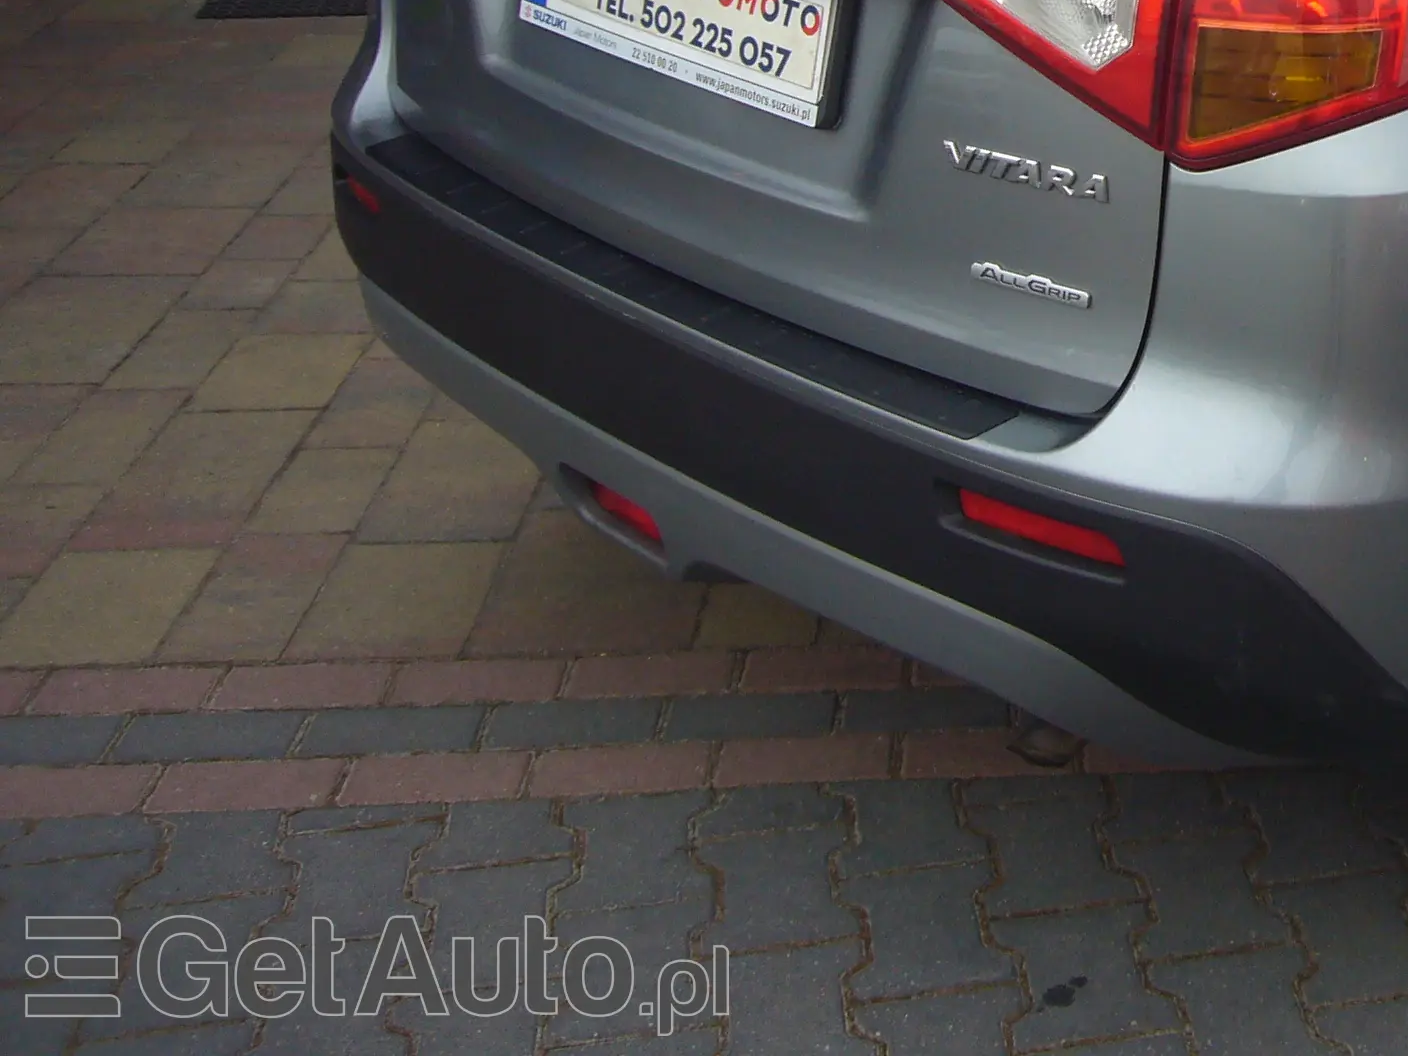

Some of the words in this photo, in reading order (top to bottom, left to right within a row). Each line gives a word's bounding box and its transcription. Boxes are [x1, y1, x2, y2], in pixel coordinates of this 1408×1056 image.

[533, 9, 567, 31] SUZUKI
[631, 47, 641, 59] 22
[642, 51, 656, 65] 510
[656, 55, 667, 68] 00
[668, 59, 678, 73] 20
[695, 71, 811, 121] www.japanmotors.suzuki.pl
[689, 18, 733, 58] 225
[739, 35, 792, 78] 057
[943, 139, 1112, 204] VITARA
